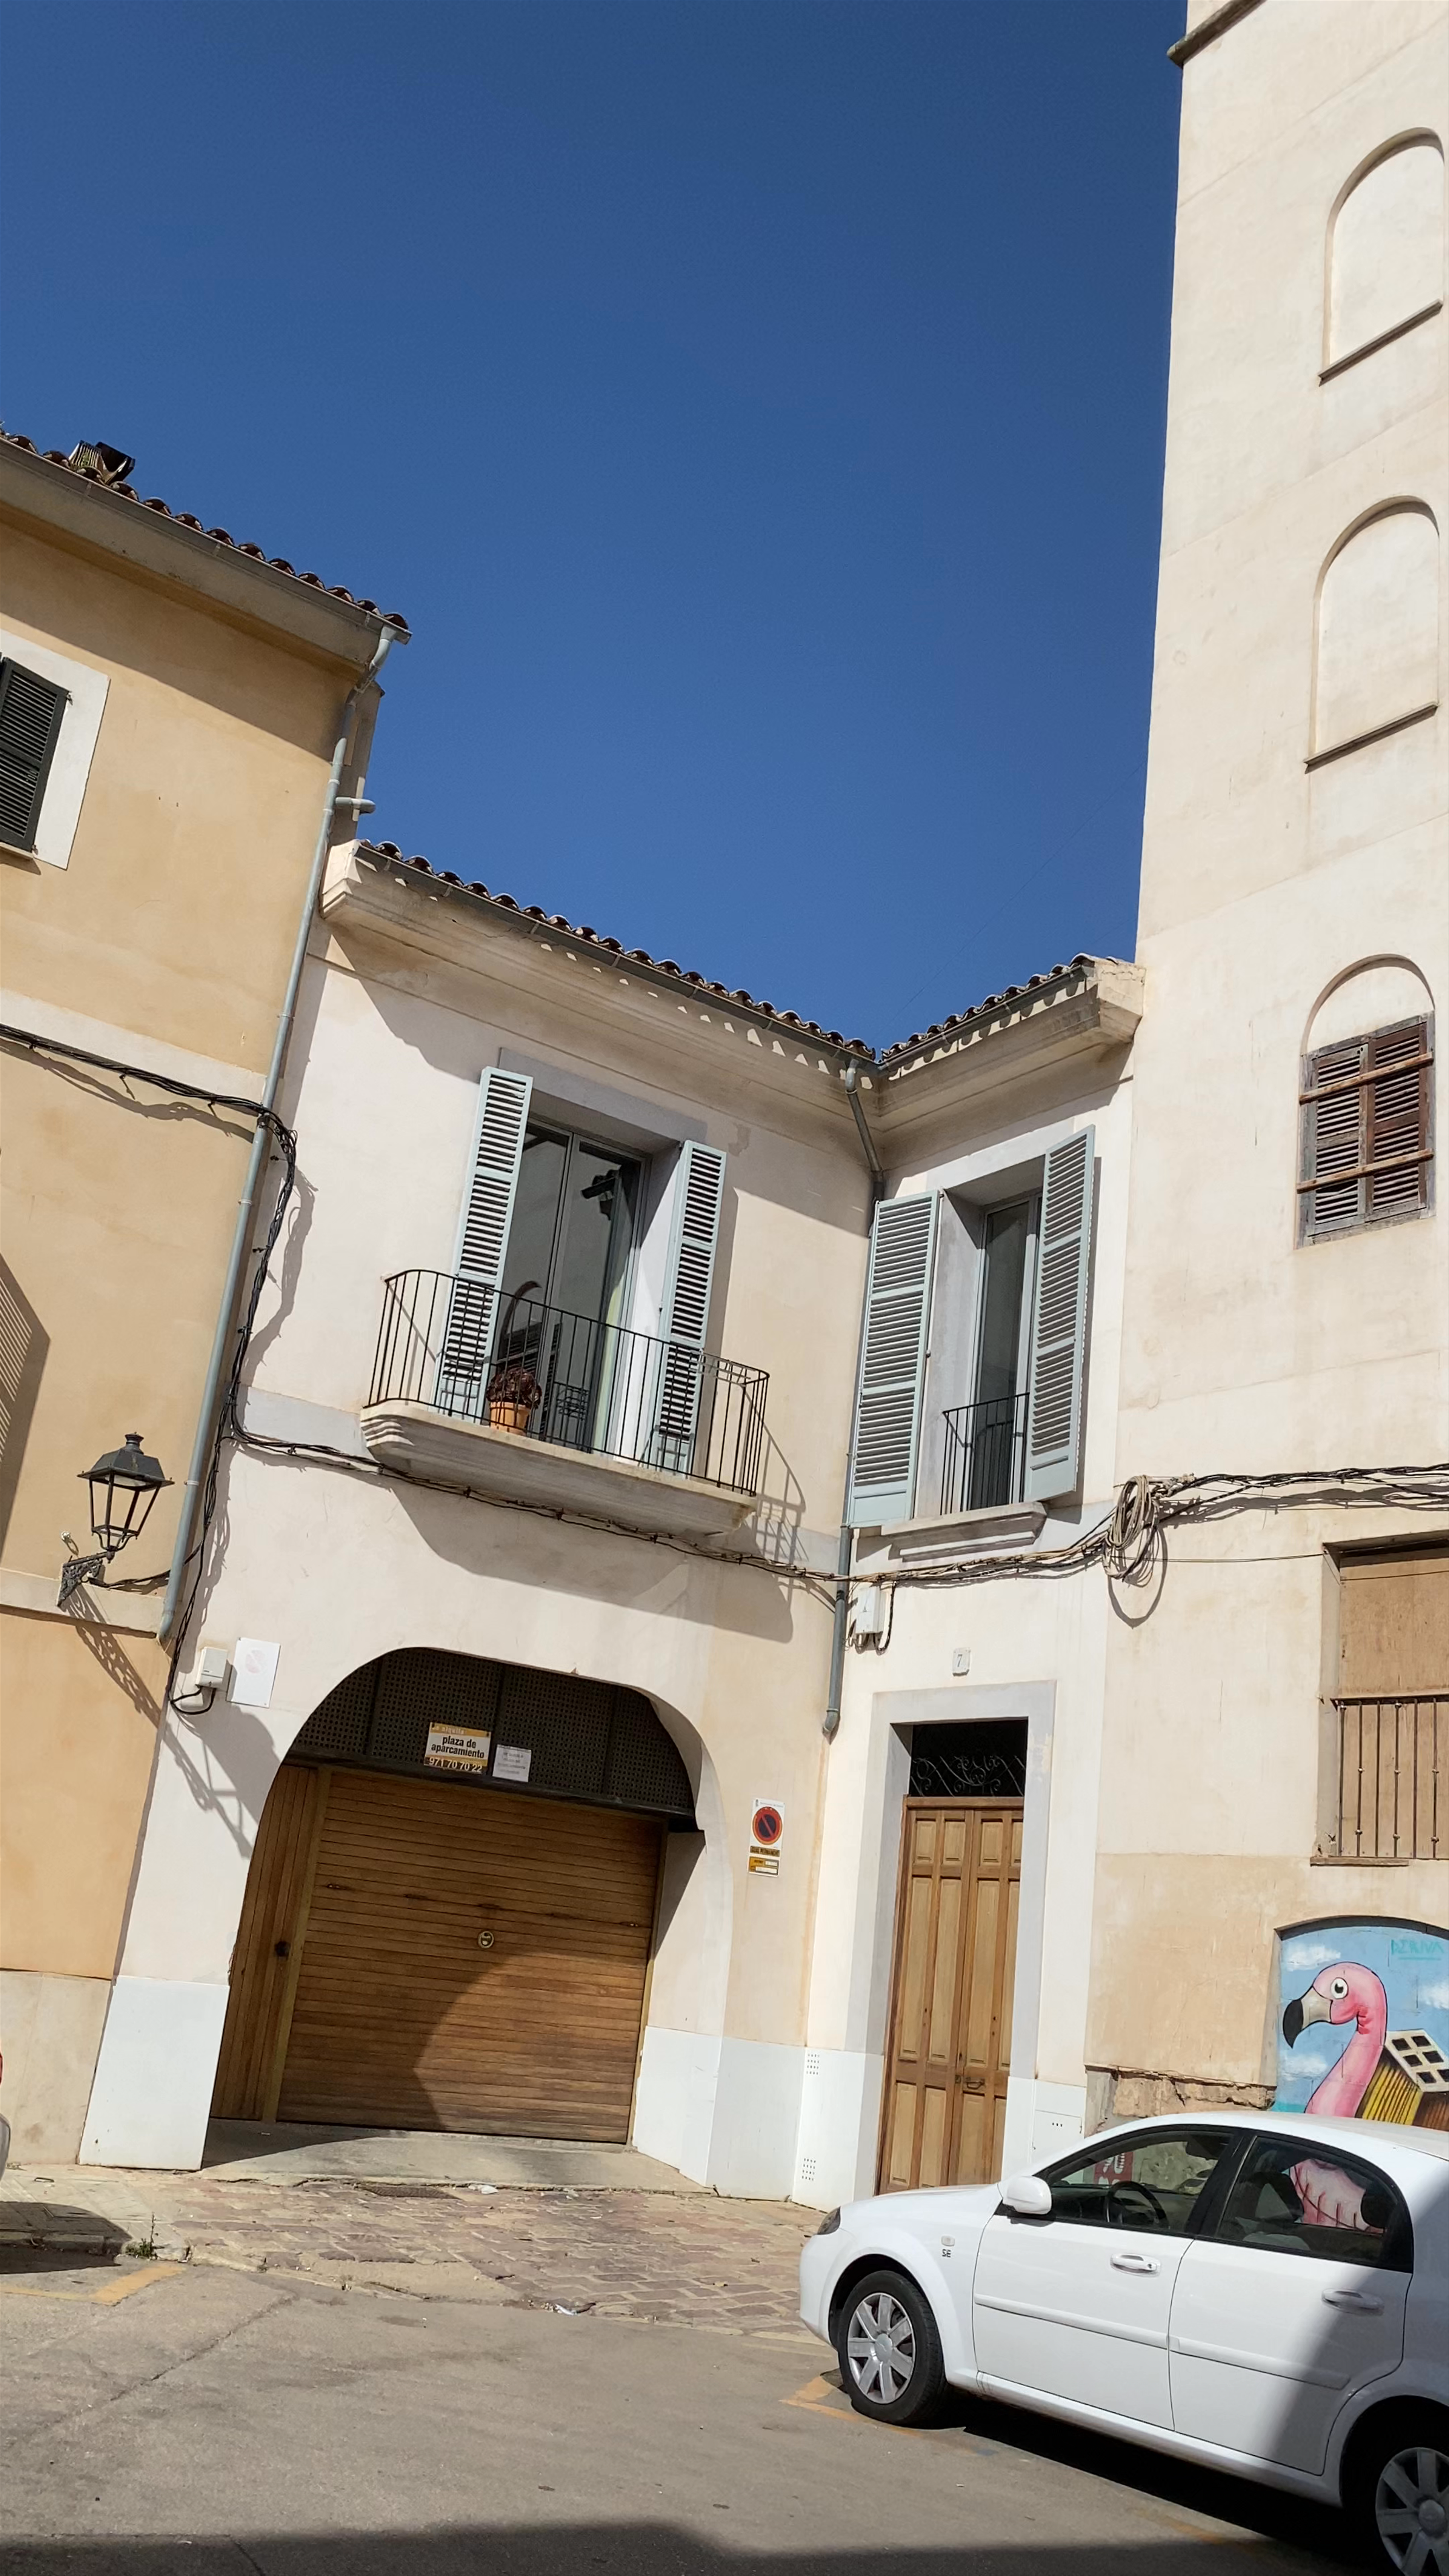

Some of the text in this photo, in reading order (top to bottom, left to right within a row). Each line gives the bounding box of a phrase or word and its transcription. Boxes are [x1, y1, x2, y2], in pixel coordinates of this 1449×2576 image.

[957, 1654, 963, 1667] 7
[442, 1736, 476, 1748] plaza de
[431, 1744, 485, 1758] aparcamiento
[429, 1757, 482, 1772] 971 70 70 22
[942, 2249, 951, 2258] SE
